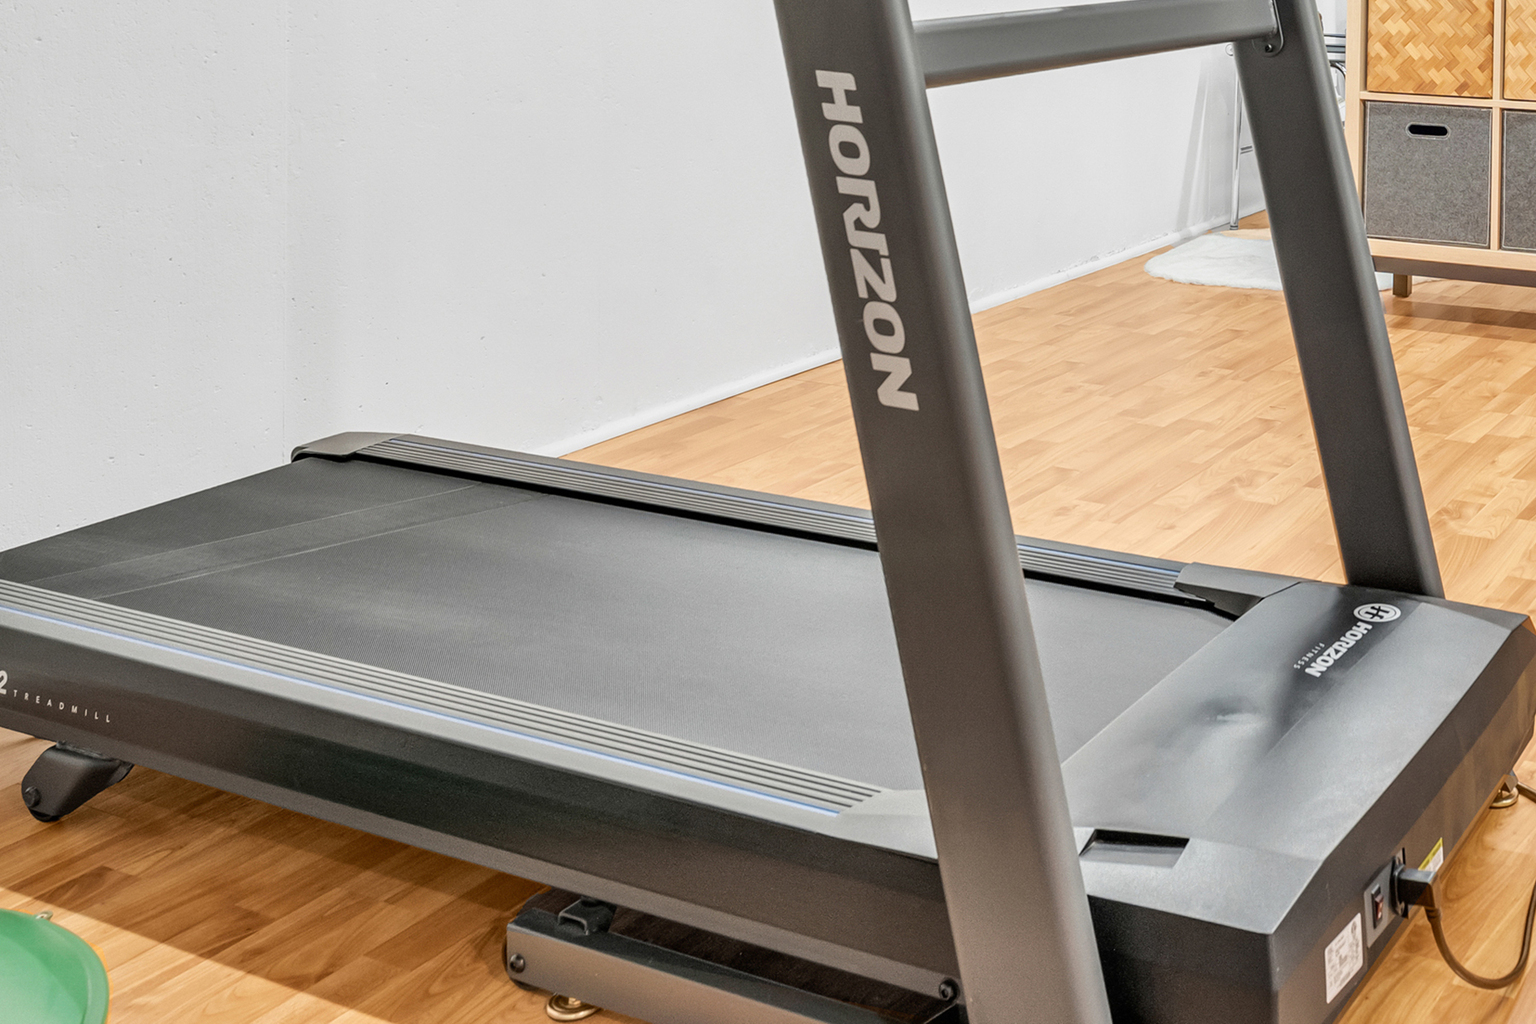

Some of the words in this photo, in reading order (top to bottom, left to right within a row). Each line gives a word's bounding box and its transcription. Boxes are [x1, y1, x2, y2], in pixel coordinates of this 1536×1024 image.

[814, 69, 920, 412] HORIZON
[1293, 642, 1326, 670] FITNESS
[1304, 621, 1373, 678] HORIZON
[13, 689, 111, 724] TREADMILL
